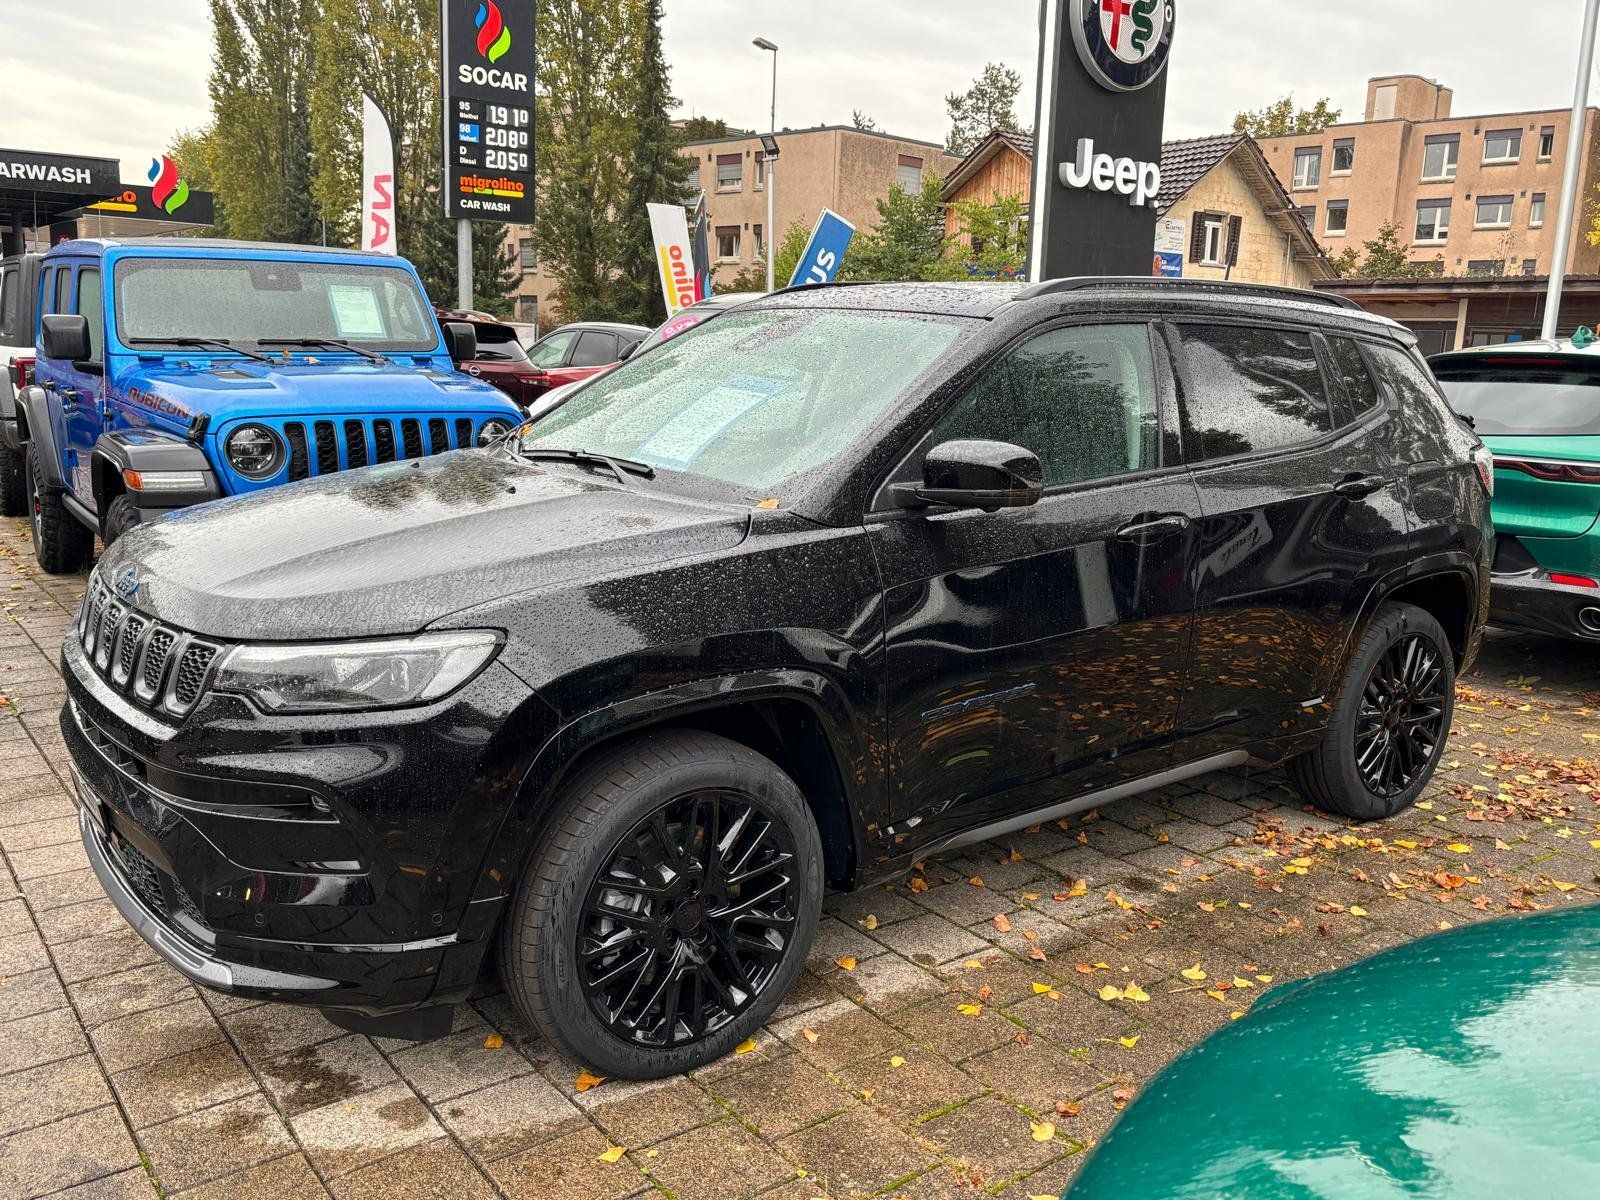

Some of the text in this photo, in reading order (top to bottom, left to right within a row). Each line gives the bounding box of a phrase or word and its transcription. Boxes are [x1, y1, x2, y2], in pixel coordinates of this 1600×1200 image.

[458, 64, 528, 92] SOCAR
[459, 101, 471, 111] 95
[459, 123, 471, 133] 98
[459, 146, 467, 155] D
[1058, 138, 1161, 208] Jeep
[459, 174, 525, 192] migrolino
[460, 199, 511, 212] CAR WASH
[127, 386, 193, 420] RUBICON
